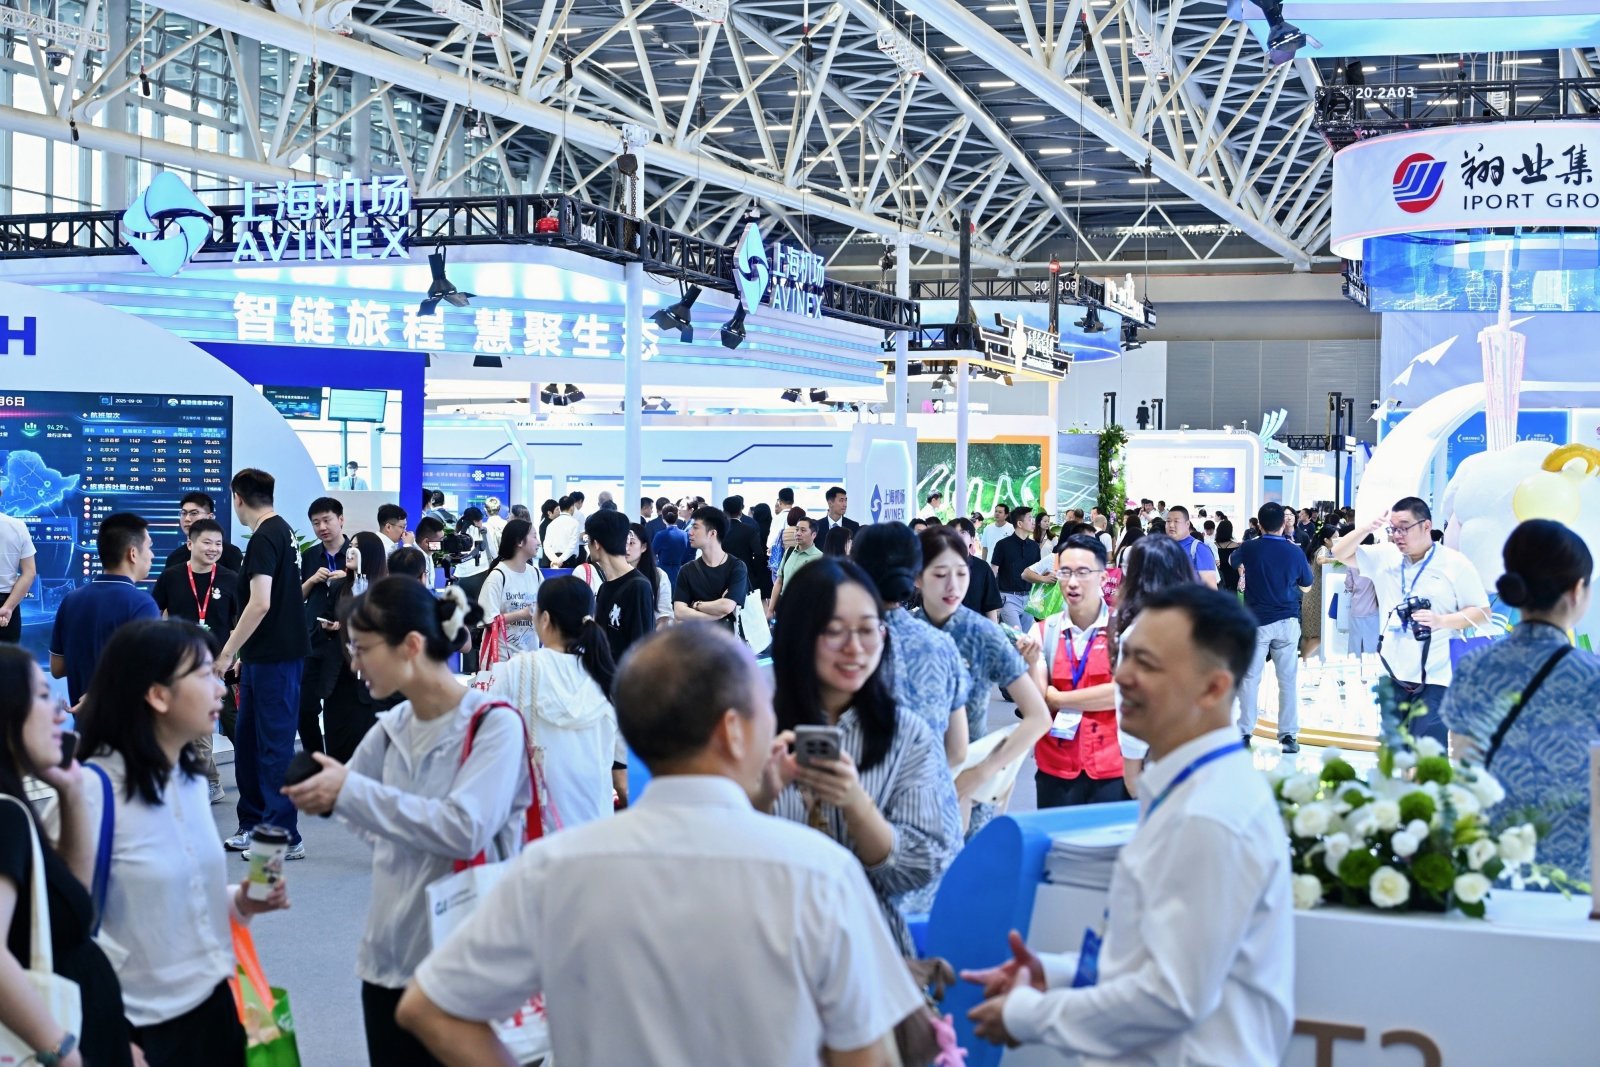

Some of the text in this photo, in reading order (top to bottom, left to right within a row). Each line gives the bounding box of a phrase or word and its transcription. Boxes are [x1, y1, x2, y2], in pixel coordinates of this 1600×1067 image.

[1355, 86, 1415, 99] 20.2A03
[1461, 142, 1594, 190] 翔业集
[231, 175, 411, 223] 上海机场
[1463, 193, 1600, 210] IPORT GRO
[231, 226, 411, 264] AVINEX
[771, 242, 825, 288] 上海机场
[771, 283, 824, 320] AVINEX
[0, 315, 36, 355] H
[232, 291, 660, 361] 智链旅程 慧聚生态
[883, 489, 905, 504] 上海机场
[883, 508, 905, 521] AVINEX
